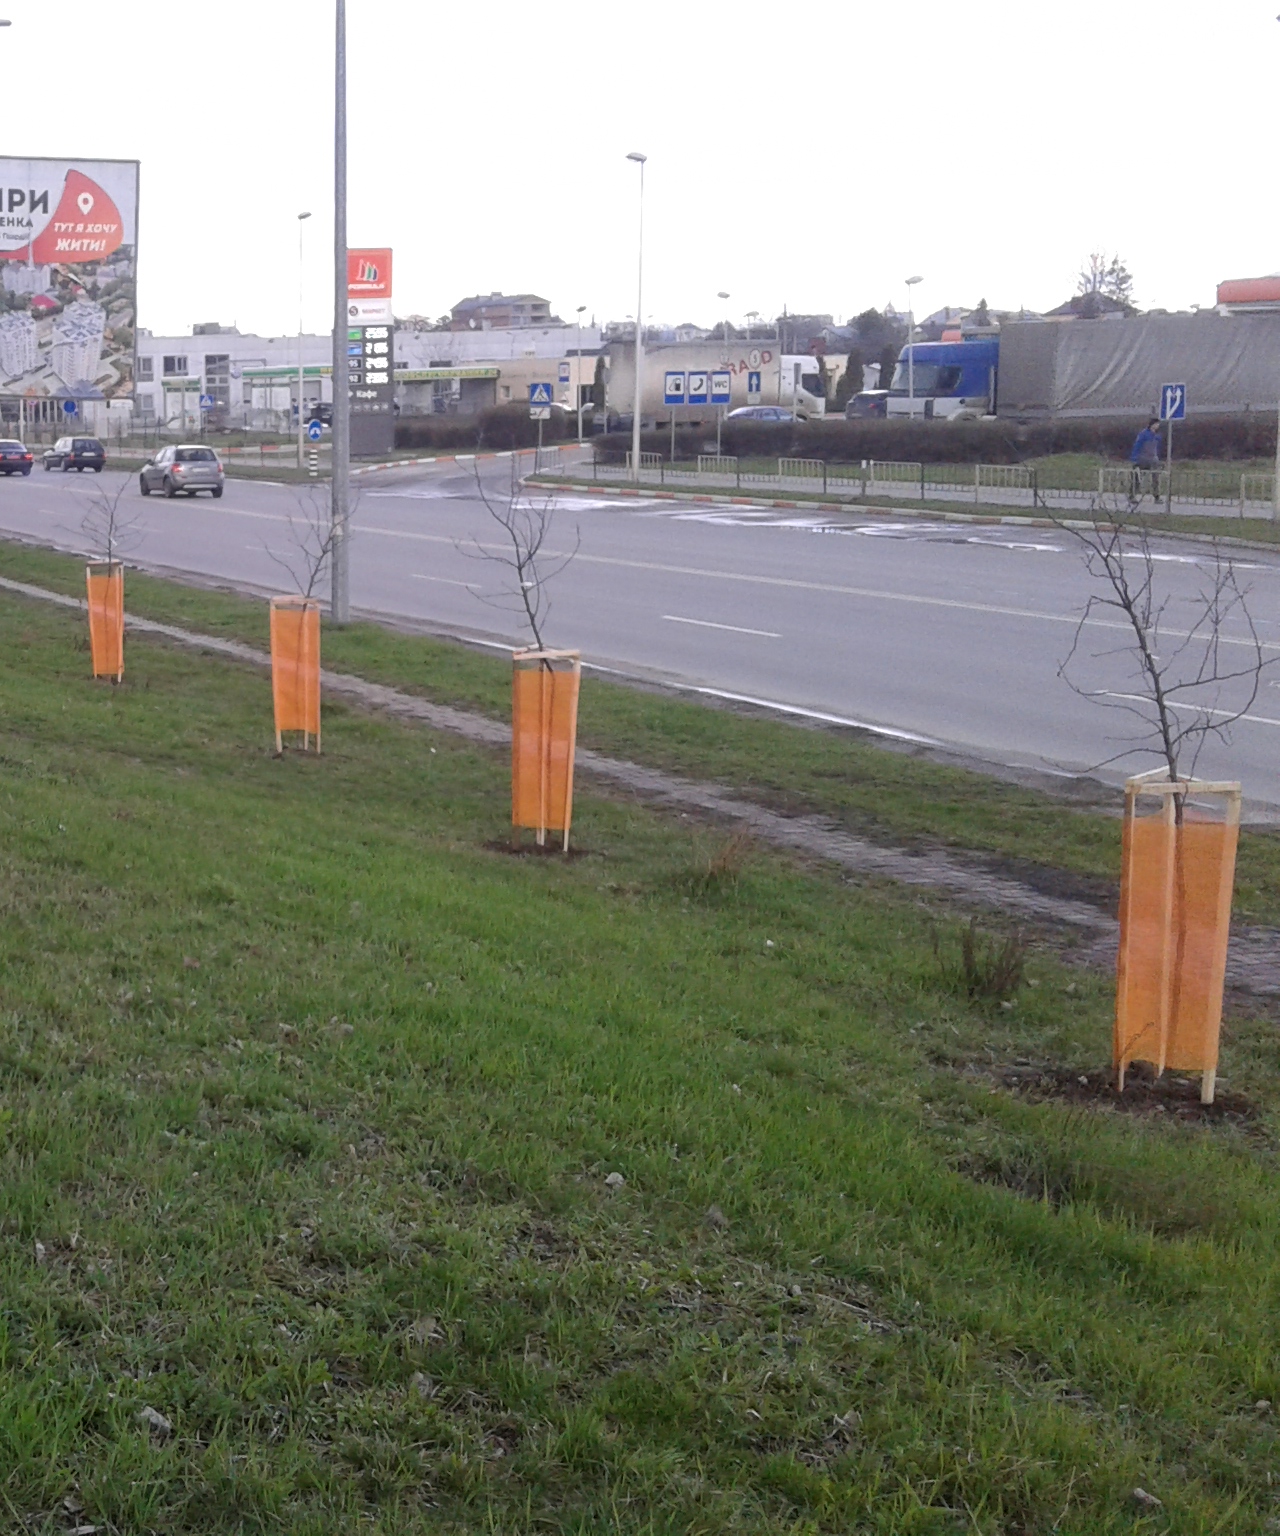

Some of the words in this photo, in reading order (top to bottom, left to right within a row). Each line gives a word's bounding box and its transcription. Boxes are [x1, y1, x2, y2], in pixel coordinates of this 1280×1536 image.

[54, 222, 74, 232] ТУТ
[75, 223, 84, 233] Я
[85, 223, 117, 234] ХОЧУ
[55, 238, 105, 251] ЖИТИ!
[714, 380, 727, 388] WC
